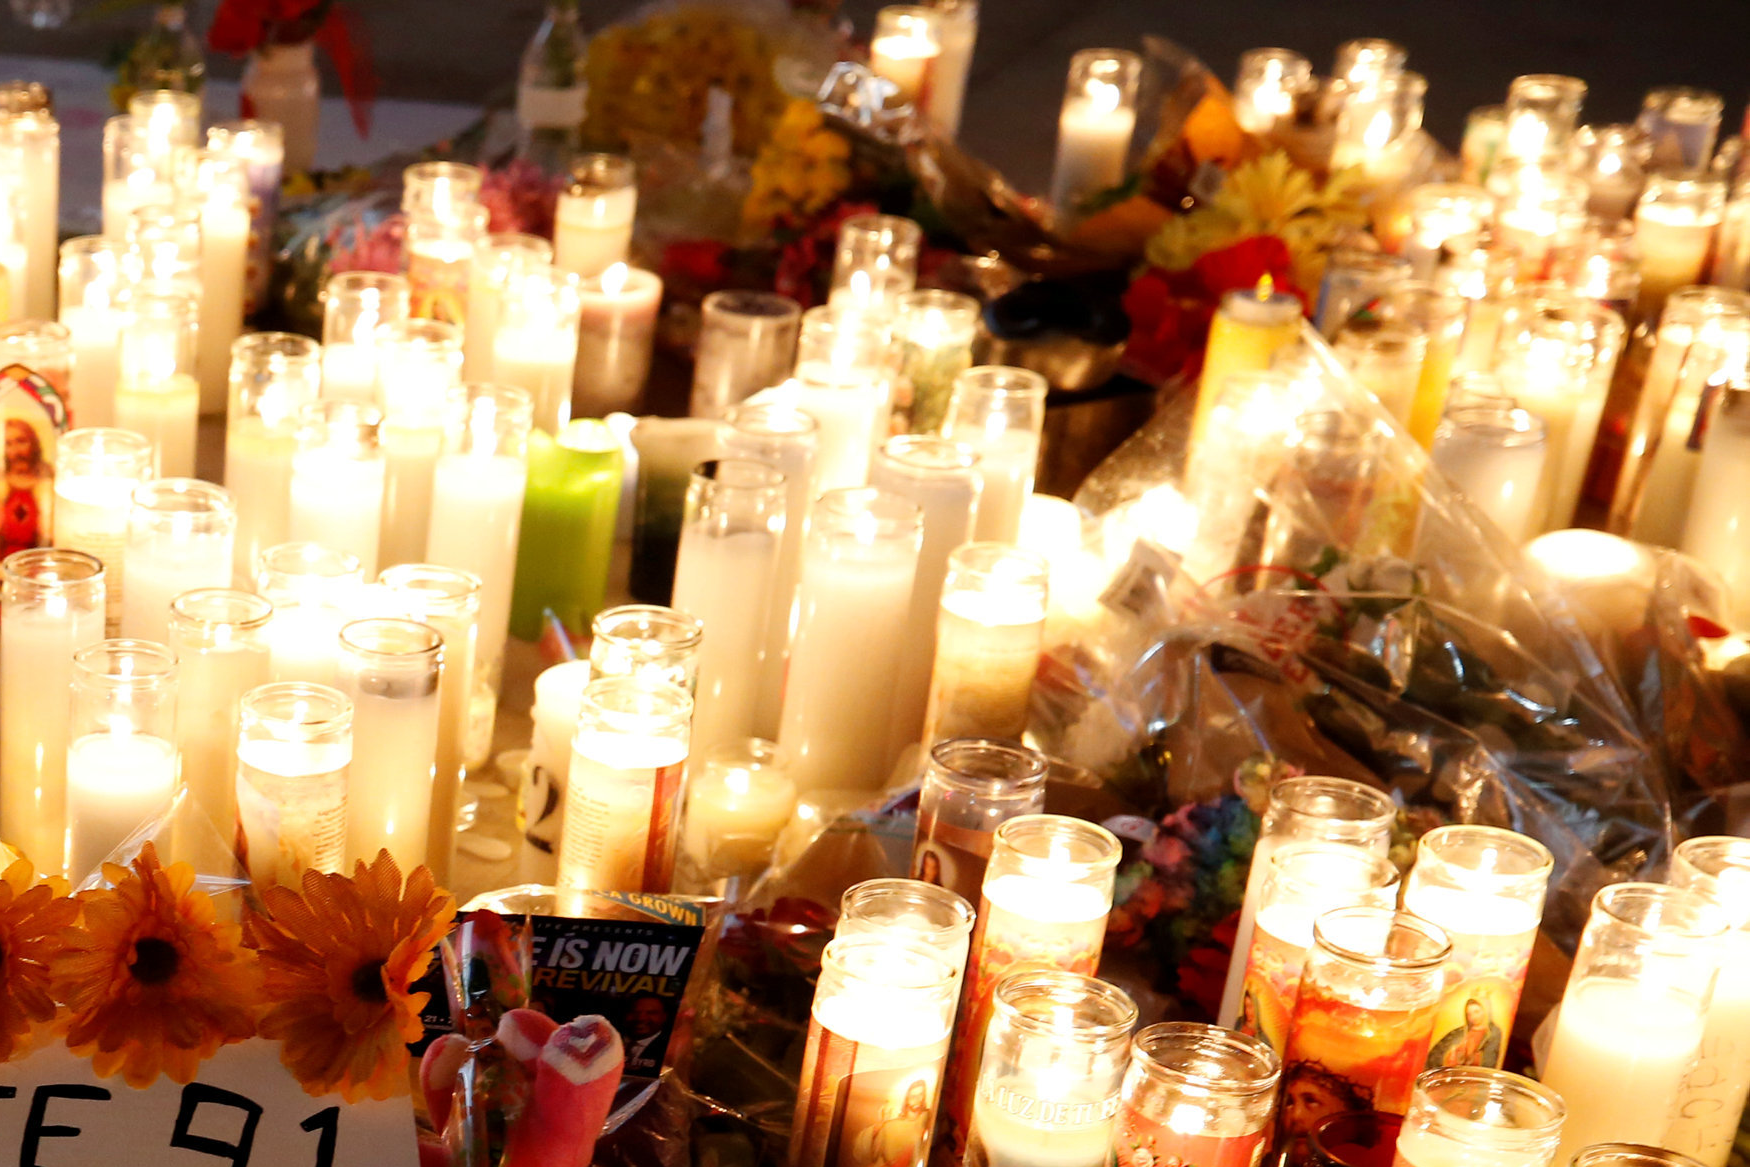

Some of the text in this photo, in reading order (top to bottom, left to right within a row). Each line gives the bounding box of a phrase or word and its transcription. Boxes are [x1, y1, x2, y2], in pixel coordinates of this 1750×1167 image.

[629, 892, 697, 926] GROWN
[547, 936, 590, 970] IS
[591, 940, 691, 977] NOW
[532, 967, 676, 998] REVIVAL
[1039, 1100, 1068, 1124] DE
